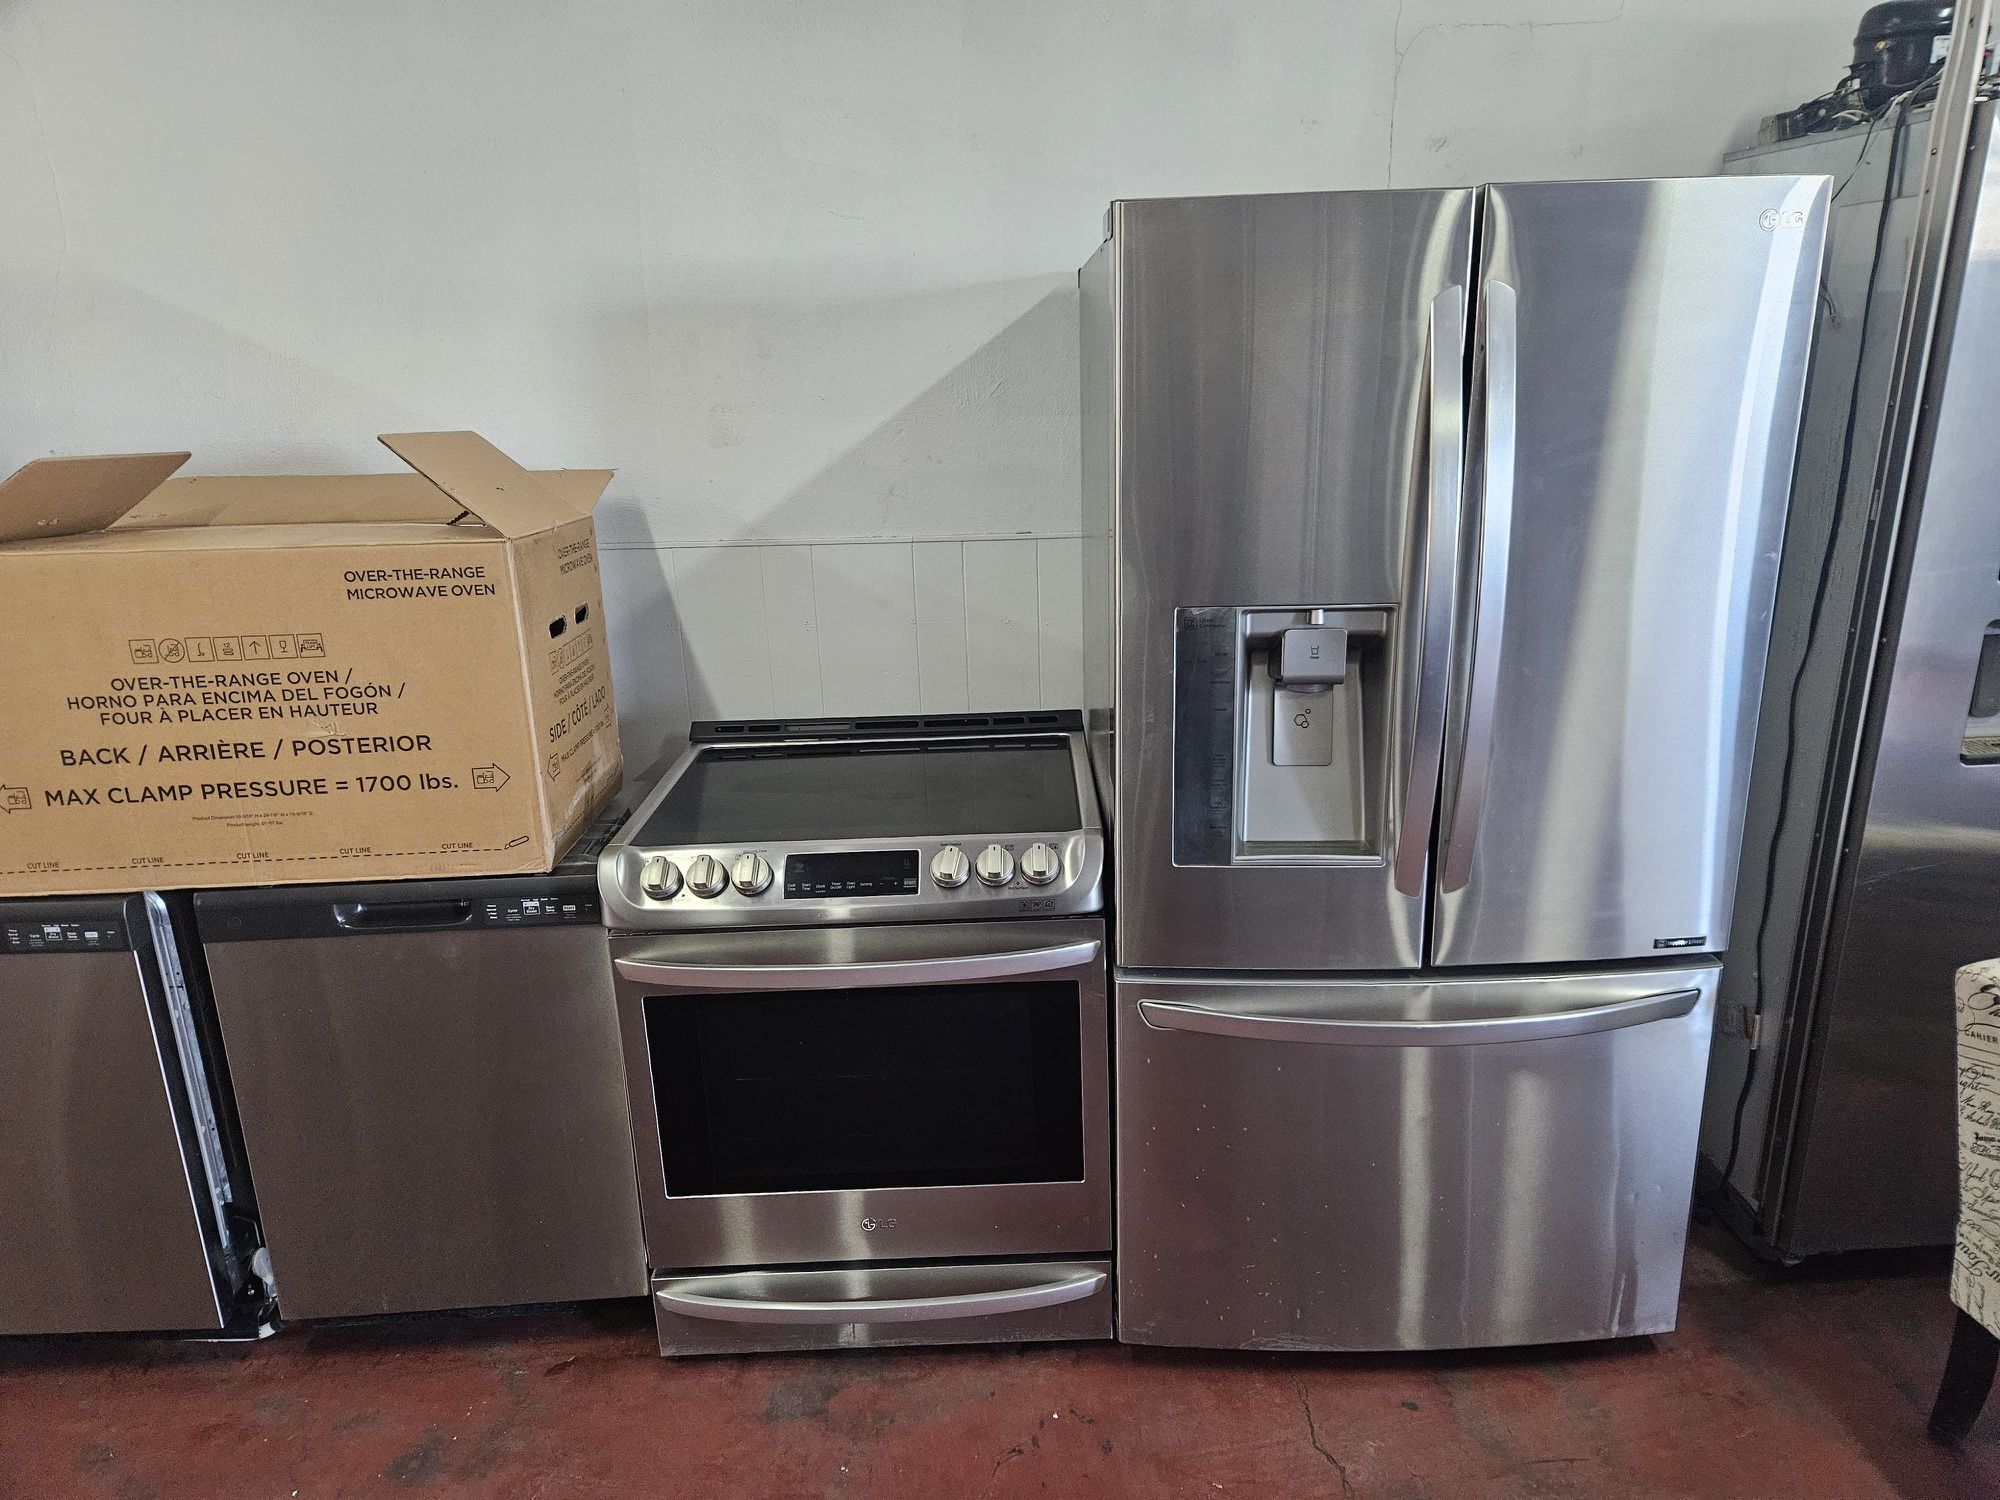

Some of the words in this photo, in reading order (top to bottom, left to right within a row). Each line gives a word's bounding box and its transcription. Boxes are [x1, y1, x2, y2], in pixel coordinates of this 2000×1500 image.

[344, 566, 486, 583] OVER-THE-RANGE
[346, 585, 449, 601] MICROWAVE
[450, 583, 496, 597] OVEN
[110, 671, 282, 692] OVER-THE-RANGE
[286, 669, 339, 685] OVEN
[66, 694, 137, 710] HORNO
[142, 692, 197, 707] PARA
[201, 689, 277, 705] ENCIMA
[281, 687, 319, 702] DEL
[323, 682, 392, 700] FOGÓN
[99, 710, 154, 726] FOUR
[159, 706, 174, 723] À
[177, 706, 254, 723] PLACER
[258, 705, 284, 720] EN
[289, 701, 379, 718] HAUTEUR
[549, 717, 567, 744] SIDE
[59, 746, 132, 767] BACK
[158, 739, 266, 763] ARRIÈRE
[291, 734, 433, 757] POSTERIOR
[44, 787, 102, 807] MAX
[107, 783, 193, 804] CLAMP
[200, 778, 329, 800] PRESSURE
[355, 774, 412, 793] 1700
[419, 772, 459, 790] lbs.
[237, 852, 252, 860] CUT
[252, 851, 270, 859] LINE
[357, 846, 372, 854] LINE
[27, 862, 42, 870] CUT
[42, 861, 60, 869] LINE
[132, 857, 146, 865] CUT
[147, 856, 164, 864] LINE
